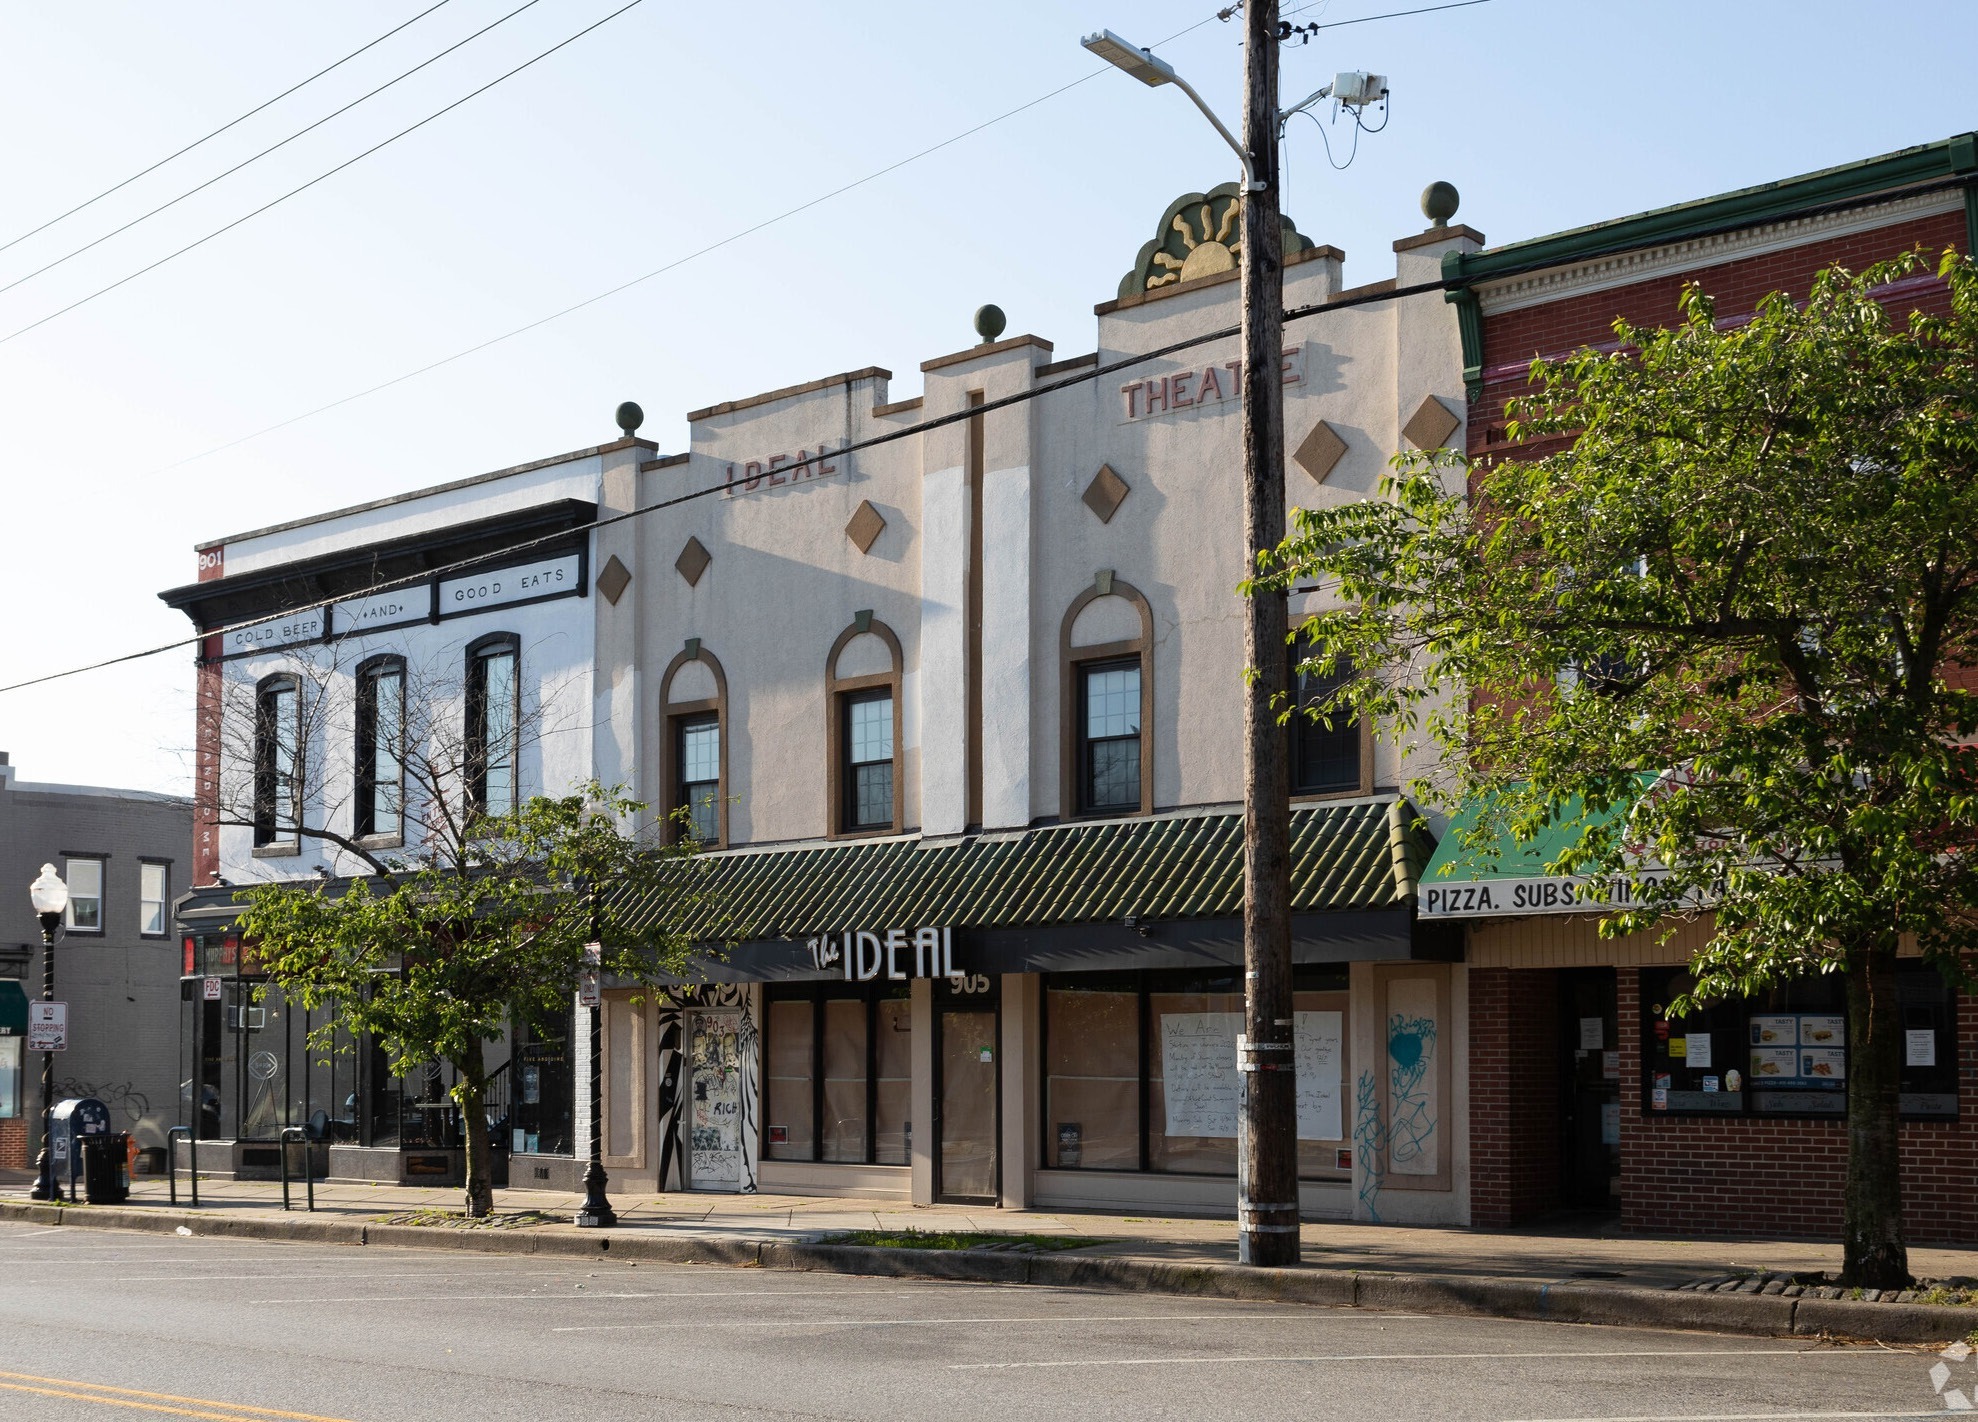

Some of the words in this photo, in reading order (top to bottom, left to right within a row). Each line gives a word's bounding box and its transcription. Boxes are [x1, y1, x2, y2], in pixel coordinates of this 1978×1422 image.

[1121, 347, 1300, 418] THEATE
[726, 445, 836, 495] IDEAL
[200, 551, 222, 571] 901
[235, 628, 273, 645] COLD
[283, 621, 318, 637] BEER
[369, 604, 398, 618] AND
[455, 582, 502, 601] GOOD
[521, 569, 564, 589] EATS
[203, 752, 212, 791] AND
[1427, 886, 1500, 913] PIZZA.
[807, 933, 840, 971] The
[844, 926, 966, 982] IDEAL
[205, 980, 220, 992] FDC
[950, 974, 991, 995] 905
[43, 1007, 54, 1016] NO
[32, 1023, 64, 1033] STOPPING
[1166, 1021, 1185, 1035] We
[713, 1102, 738, 1116] RICH
